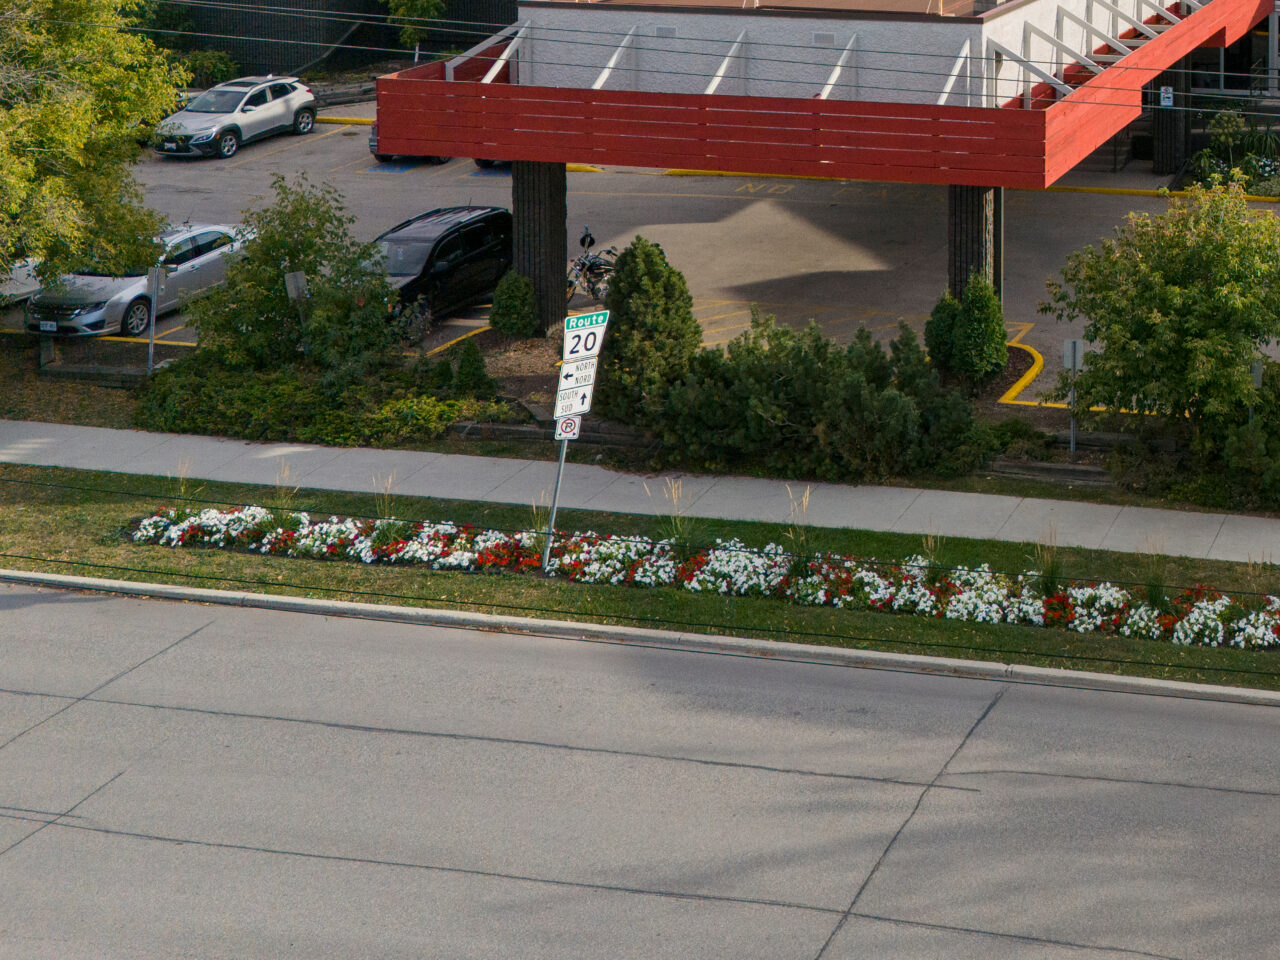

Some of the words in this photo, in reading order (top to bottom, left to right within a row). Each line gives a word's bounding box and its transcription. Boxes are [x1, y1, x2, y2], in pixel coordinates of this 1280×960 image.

[735, 183, 794, 194] NO
[568, 314, 604, 329] Route
[569, 331, 597, 355] 20
[576, 362, 595, 373] NORTH
[574, 373, 592, 385] NORD
[559, 389, 579, 402] SOUTH
[560, 403, 573, 414] SUD
